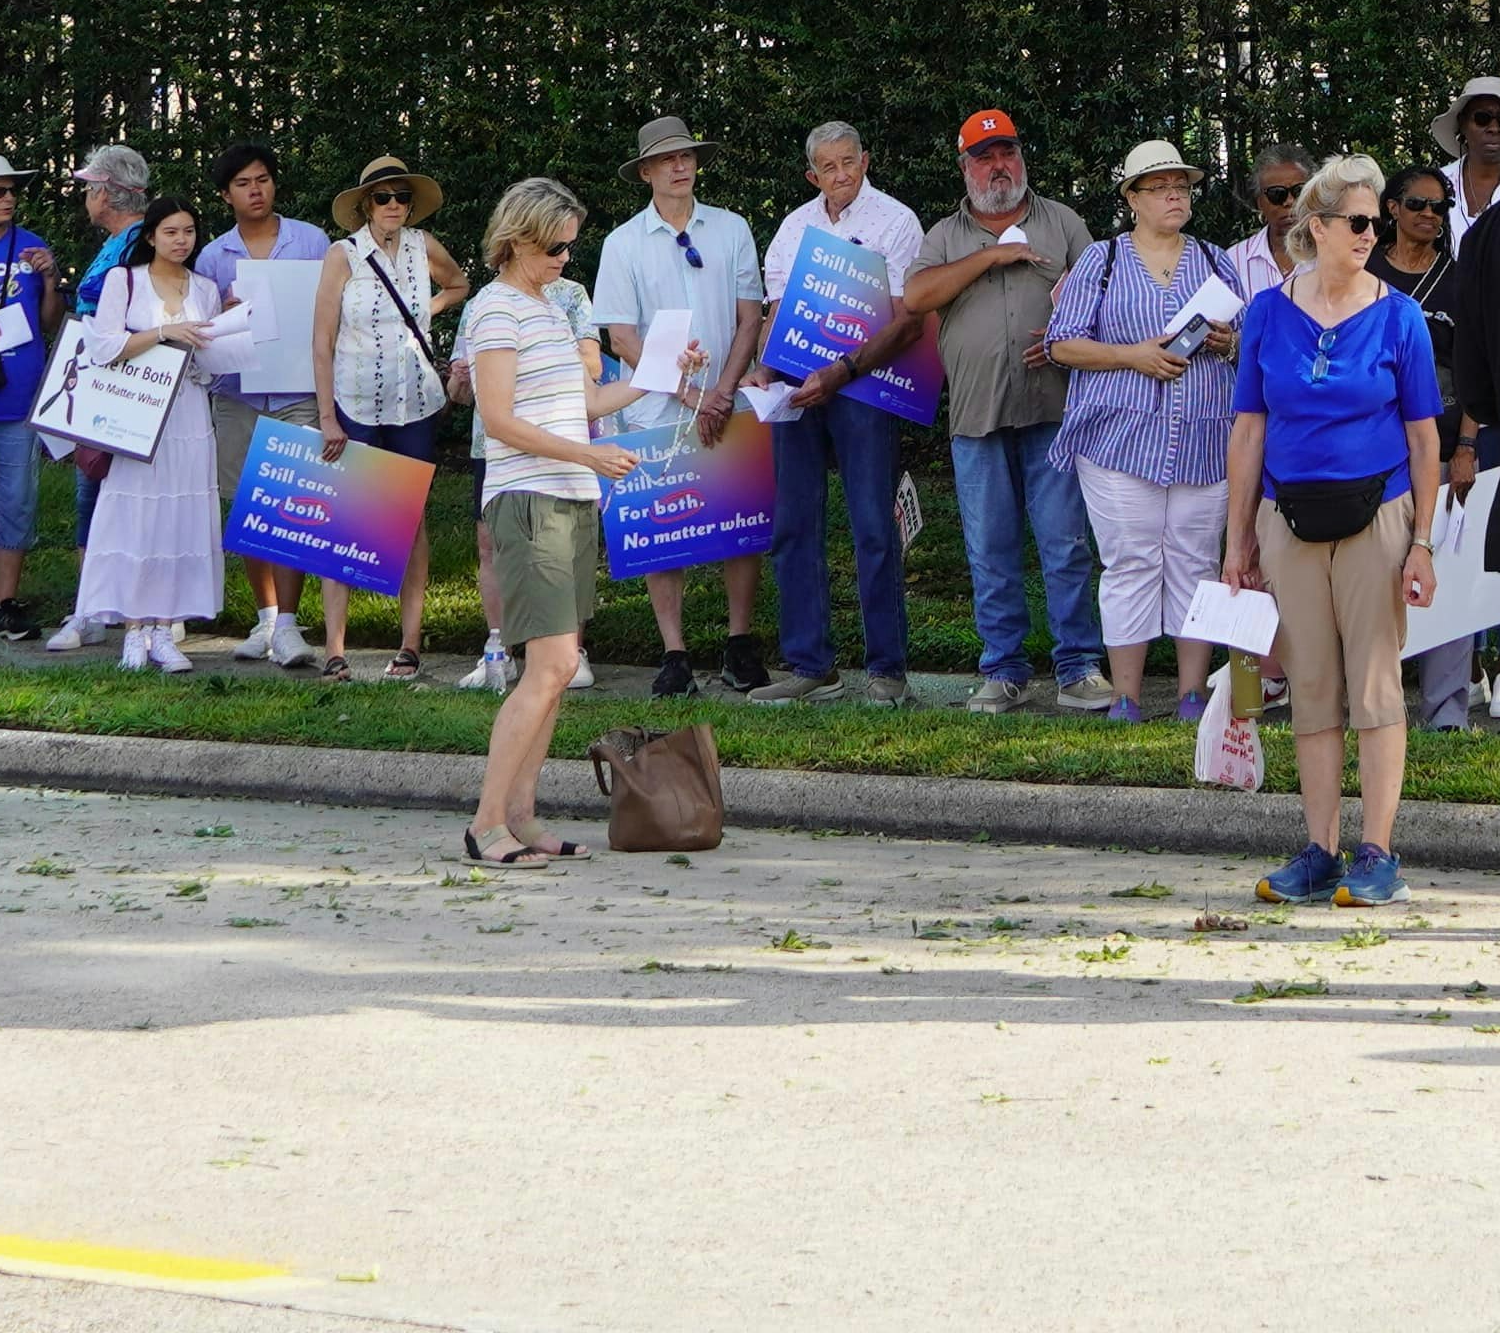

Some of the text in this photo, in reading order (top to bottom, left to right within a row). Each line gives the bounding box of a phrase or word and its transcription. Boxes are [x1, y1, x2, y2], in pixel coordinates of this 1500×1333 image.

[811, 247, 884, 291] Still here.
[802, 273, 877, 317] Still care.
[793, 300, 869, 343] For both.
[122, 359, 140, 377] for
[142, 366, 173, 386] Both
[784, 327, 916, 392] No what.
[91, 379, 165, 408] No Matter What!
[265, 436, 302, 457] Still
[258, 461, 338, 497] Still care.
[614, 476, 652, 495] Still
[251, 486, 331, 523] For both.
[618, 494, 705, 522] For both.
[243, 513, 269, 533] No
[271, 525, 332, 549] matter
[332, 542, 381, 566] what.
[623, 511, 771, 551] No matter what.
